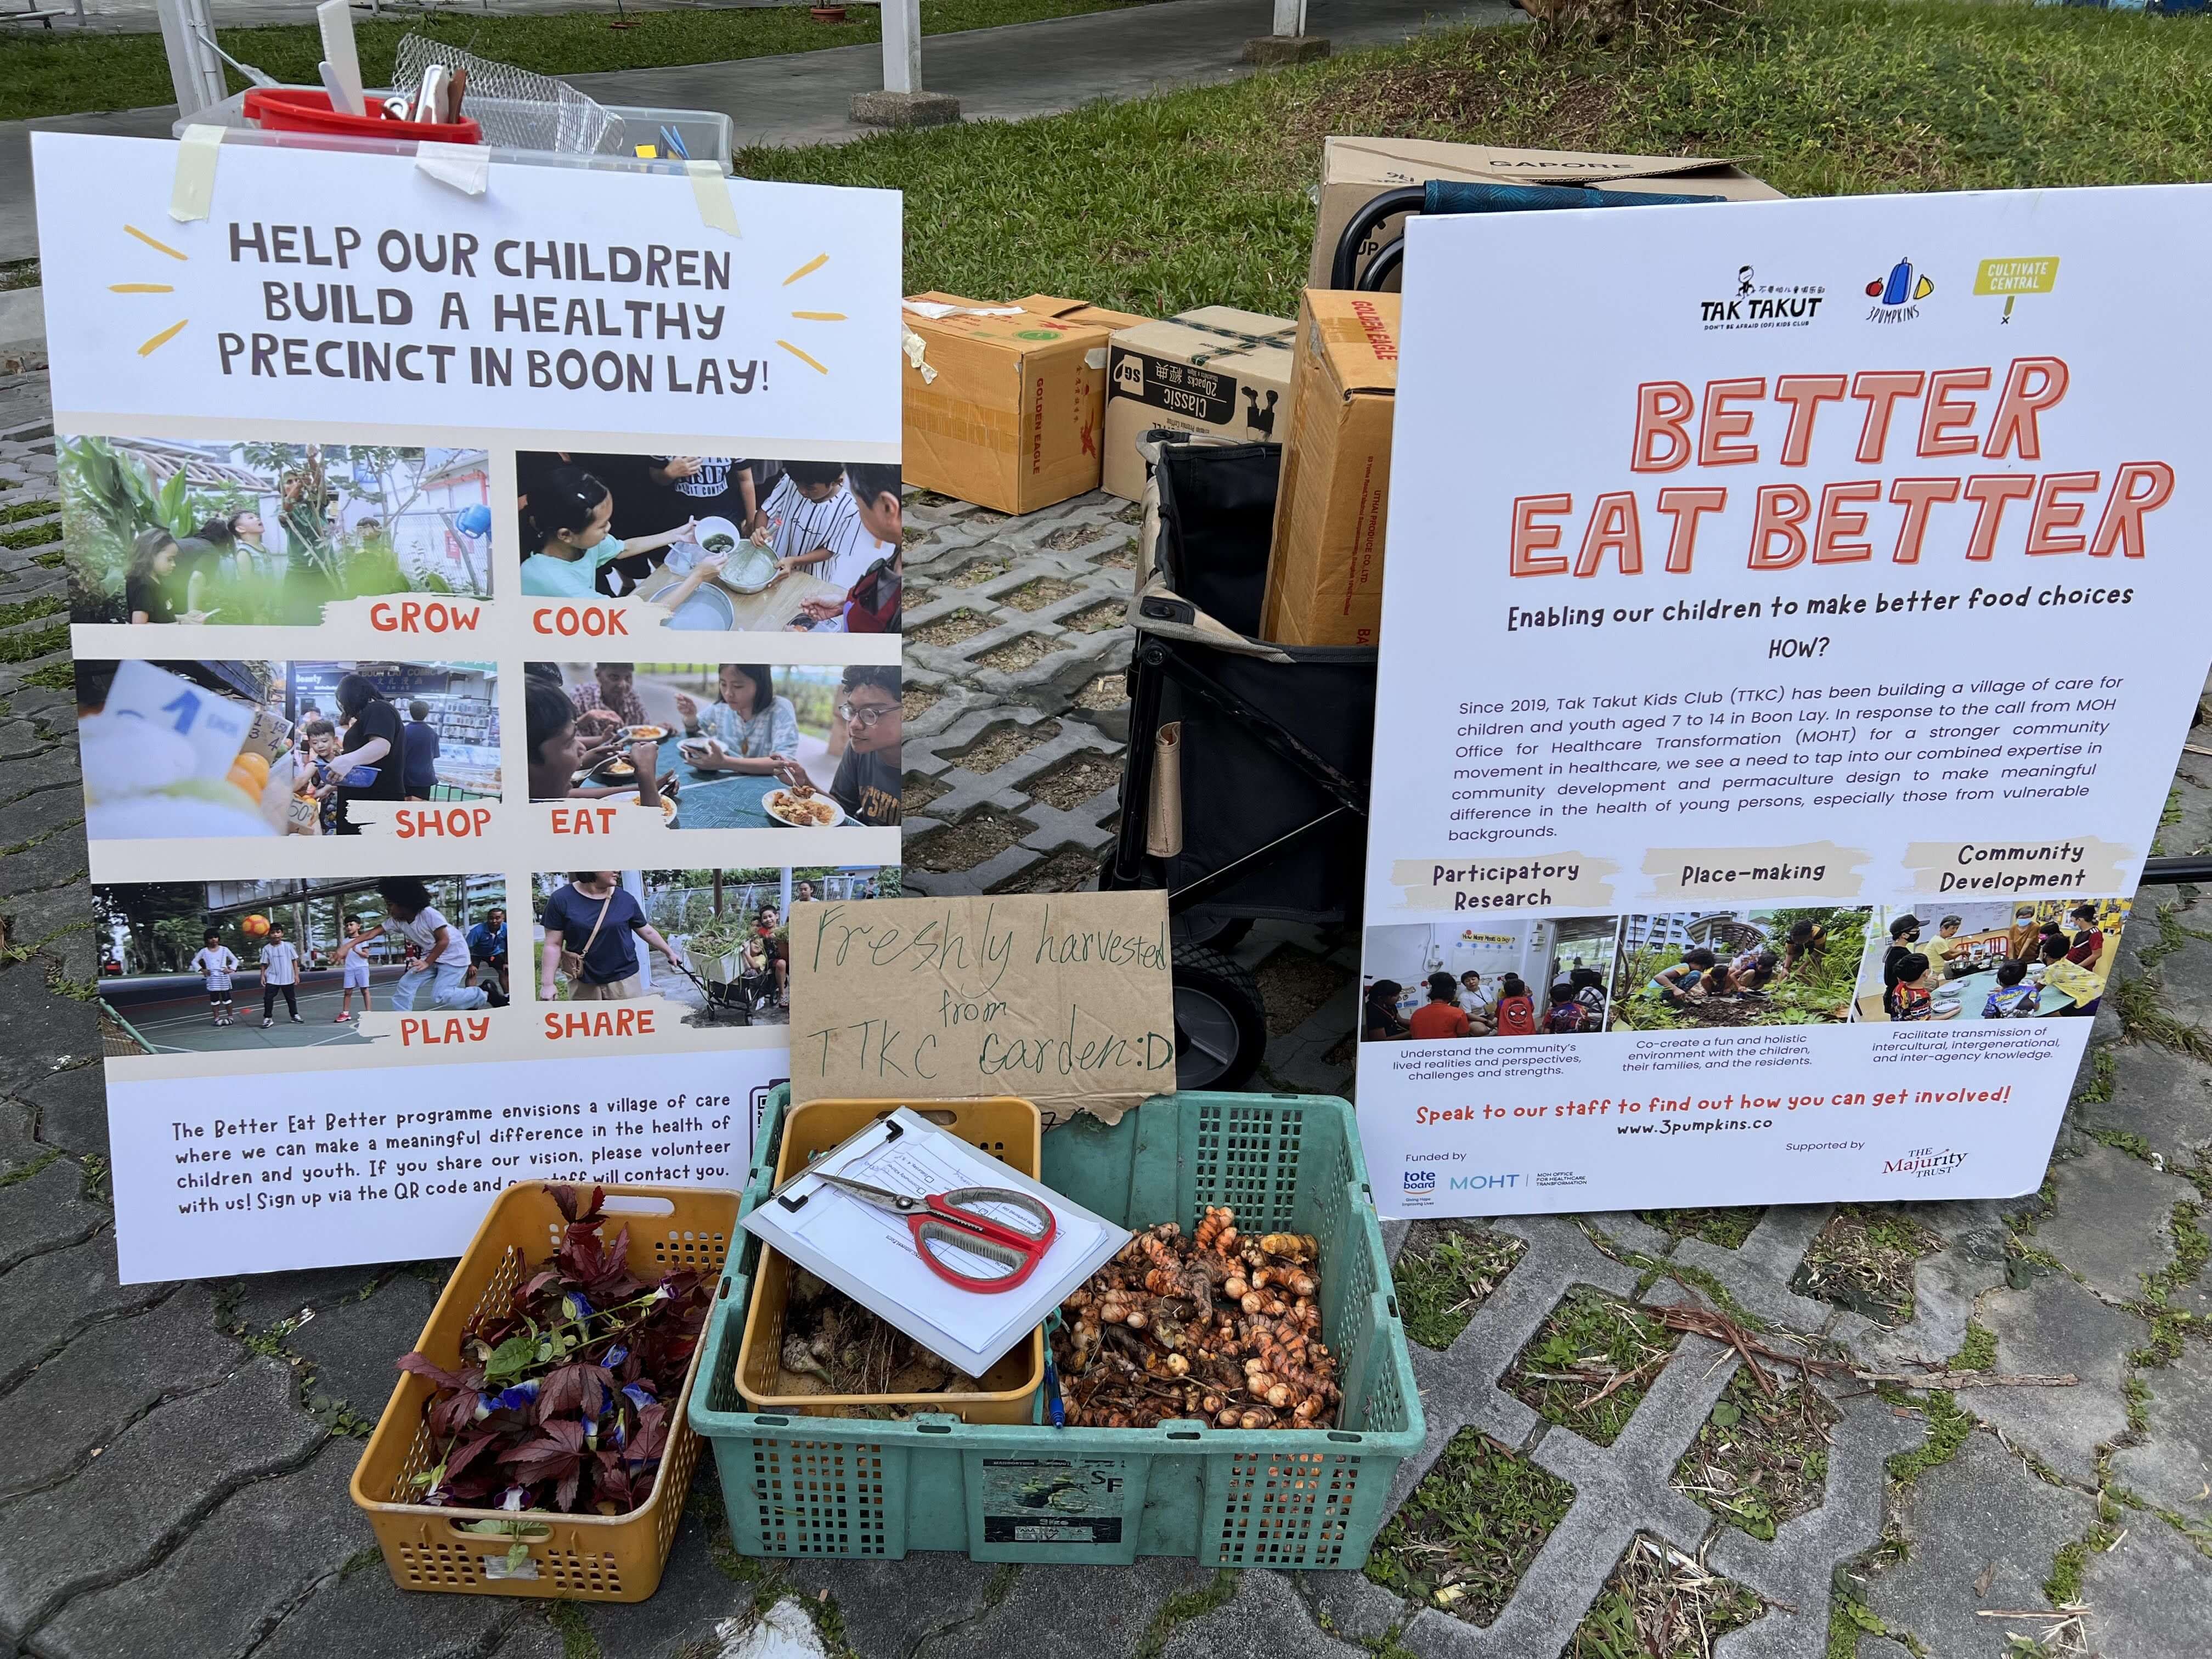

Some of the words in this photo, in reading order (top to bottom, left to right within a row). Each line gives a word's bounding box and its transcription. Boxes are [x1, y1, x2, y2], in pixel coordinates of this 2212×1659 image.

[229, 222, 362, 269] HELP
[377, 229, 479, 278] OUR
[494, 239, 731, 290] CHILDREN
[1988, 262, 2049, 276] CULTIVATE
[1990, 276, 2039, 290] CENTRAL
[262, 281, 413, 325] BUILD
[439, 292, 470, 330] A
[494, 294, 725, 341] HEALTHY
[1351, 301, 1386, 332] GOLDEN
[1701, 301, 1742, 321] TAK
[1748, 297, 1823, 319] TAKUT
[1866, 304, 1919, 324] 3PUMPKINS
[1366, 334, 1398, 360] EAGLE
[217, 332, 456, 384] PRECINCT
[470, 346, 512, 387] IN
[526, 348, 653, 393] BOON
[667, 355, 769, 395] LAY!
[1125, 366, 1141, 383] SG
[1155, 361, 1182, 384] 經典
[1035, 378, 1044, 431] GOLDEN
[1164, 388, 1207, 418] Classic
[1630, 356, 2069, 474] BETTER
[1032, 433, 1041, 475] EAGLE
[1372, 490, 1381, 512] UTHAI
[1509, 486, 1728, 579] EAT
[1746, 460, 2175, 571] BETTER
[1366, 515, 1377, 552] PRODUCE
[370, 602, 479, 633] GROW
[533, 606, 628, 636] COOK
[1507, 605, 1605, 632] Enabling
[1612, 607, 1655, 623] our
[1662, 598, 1762, 622] children
[1770, 596, 1798, 618] to
[1806, 594, 1867, 615] make
[1875, 590, 1961, 614] better
[1968, 585, 2033, 610] food
[2038, 584, 2134, 606] choices
[1768, 636, 1830, 659] HOW?
[1459, 702, 1504, 715] Since
[1510, 698, 1550, 713] 2019,
[1556, 697, 1587, 710] Tak
[1592, 695, 1638, 709] Takut
[1643, 693, 1678, 707] Kids
[1684, 691, 1723, 704] Club
[1730, 685, 1785, 706] (TTKC)
[1791, 687, 1822, 700] has
[1828, 686, 1871, 698] been
[1877, 682, 1946, 698] building
[1951, 684, 1964, 694] a
[1970, 680, 2025, 696] village
[2032, 678, 2051, 691] of
[2055, 679, 2094, 690] care
[2100, 675, 2124, 689] for
[396, 808, 491, 838] SHOP
[551, 808, 617, 834] EAT
[1958, 842, 2085, 865] Community
[1433, 861, 1579, 887] Participatory
[1681, 863, 1826, 887] Place-making
[1939, 868, 2086, 893] Development
[1454, 888, 1551, 911] Research
[814, 904, 1013, 998] Freshly
[1036, 904, 1166, 970] harvested
[939, 990, 1006, 1027] from
[401, 1017, 490, 1046] PLAY
[545, 1008, 655, 1040] SHARE
[1892, 1030, 1949, 1040] Facilitate
[1951, 1028, 2032, 1038] transmission
[2034, 1026, 2049, 1036] of
[1871, 1041, 1949, 1052] intercultural,
[1951, 1037, 2061, 1051] intergenerational,
[1872, 1053, 1898, 1063] and
[1900, 1053, 1982, 1063] inter-agency
[1983, 1049, 2053, 1061] knowledge.
[172, 1122, 205, 1141] The
[215, 1118, 278, 1138] Better
[288, 1114, 316, 1133] Eat
[325, 1111, 387, 1131] Better
[397, 1109, 493, 1128] programme
[502, 1104, 580, 1119] envisions
[589, 1102, 597, 1113] a
[607, 1097, 658, 1113] village
[667, 1093, 687, 1109] of
[695, 1095, 730, 1108] care
[1415, 1105, 1475, 1126] Speak
[1482, 1104, 1506, 1120] to
[1513, 1106, 1548, 1118] our
[1555, 1099, 1611, 1117] staff
[1617, 1098, 1641, 1114] to
[1648, 1096, 1691, 1113] find
[1697, 1094, 1734, 1110] out
[1740, 1093, 1781, 1109] how
[1787, 1096, 1825, 1110] you
[1831, 1093, 1865, 1106] can
[1871, 1088, 1909, 1107] get
[1914, 1085, 2012, 1104] involved!
[1617, 1118, 1773, 1136] www.3pumpkins.co
[1406, 1152, 1449, 1163] Funded
[1452, 1152, 1468, 1162] by
[1785, 1141, 1848, 1153] Supported
[1850, 1141, 1865, 1150] by
[1908, 1147, 1933, 1157] THE
[1403, 1180, 1435, 1189] board
[1404, 1171, 1436, 1182] tote
[1449, 1174, 1520, 1190] MOHT
[1916, 1166, 1954, 1178] TRUST
